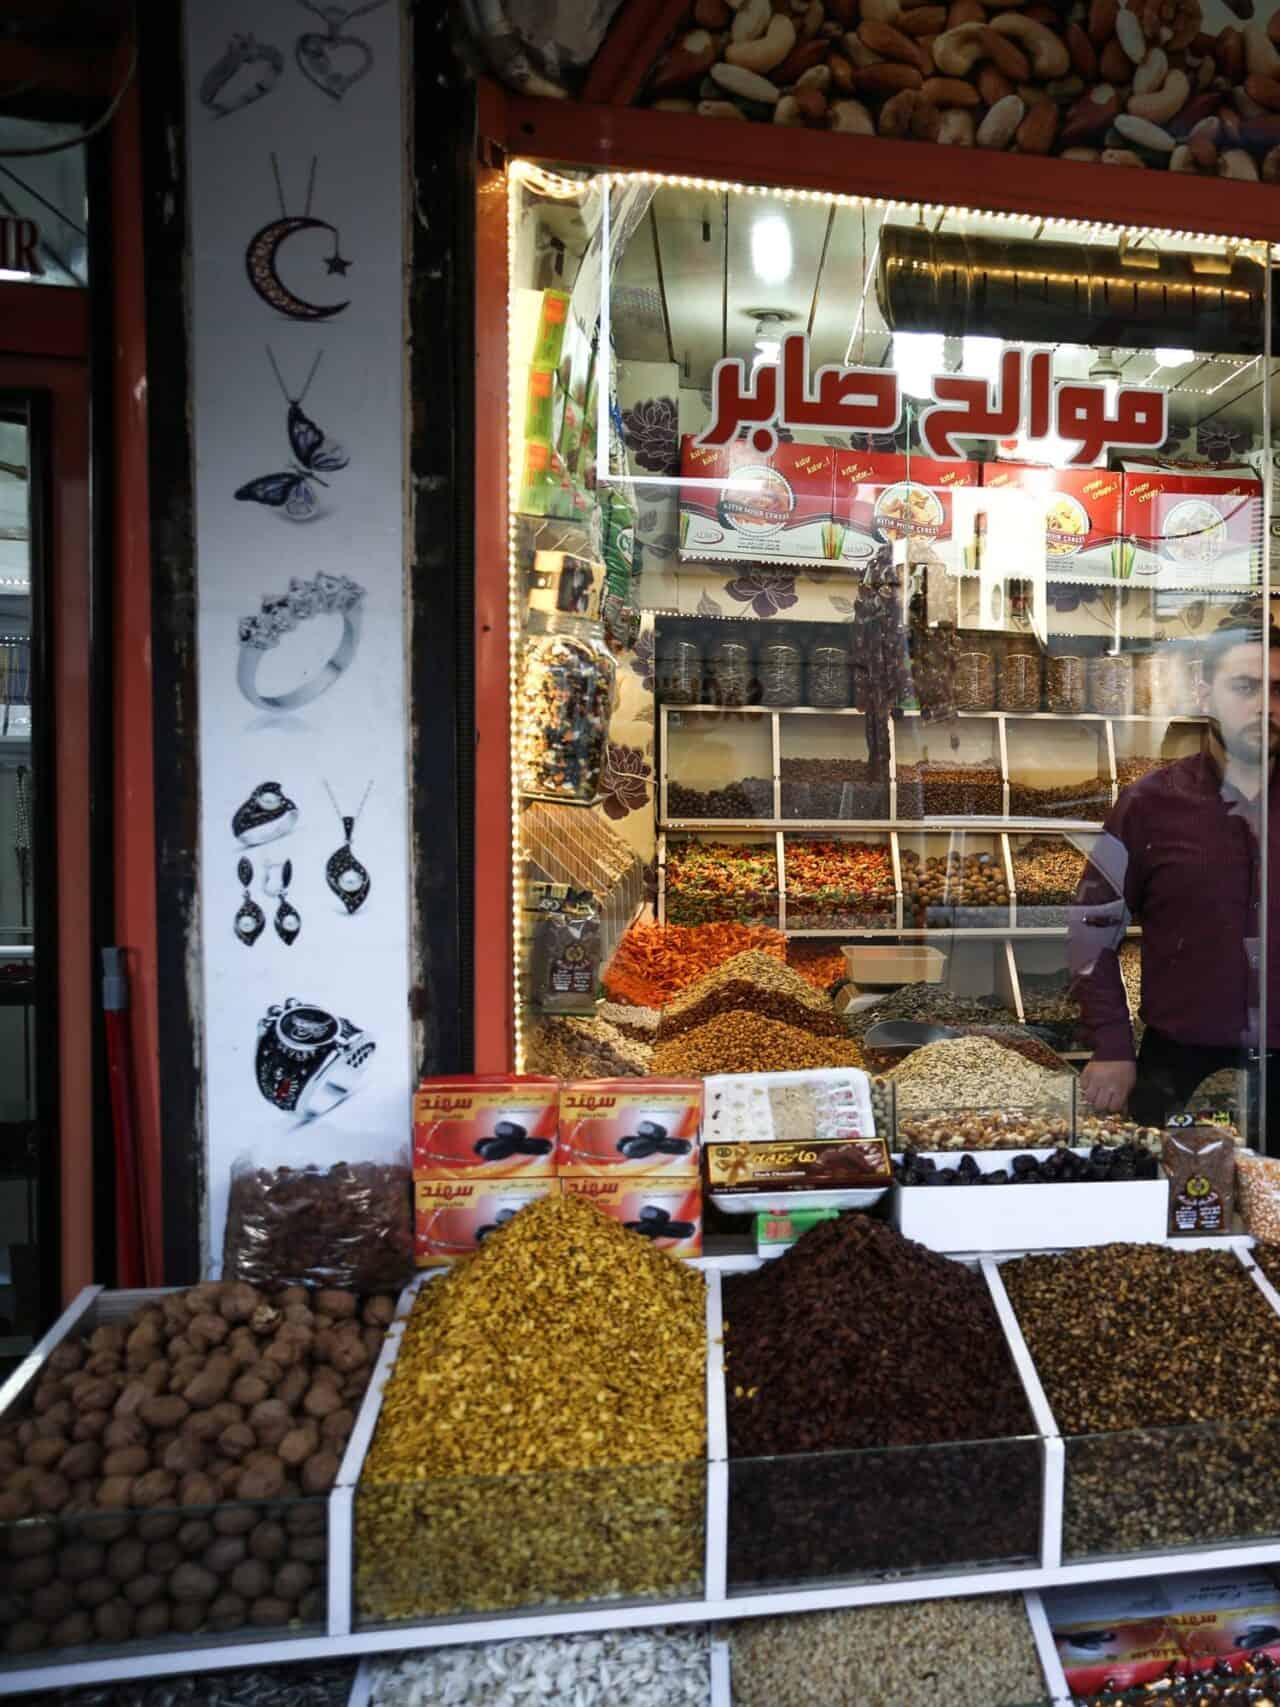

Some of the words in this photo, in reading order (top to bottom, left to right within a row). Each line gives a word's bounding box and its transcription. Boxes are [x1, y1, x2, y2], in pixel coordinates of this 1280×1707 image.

[694, 330, 902, 457] صابر
[918, 347, 1168, 467] موالح
[564, 1093, 616, 1111] سهند
[420, 1181, 474, 1200] سهند
